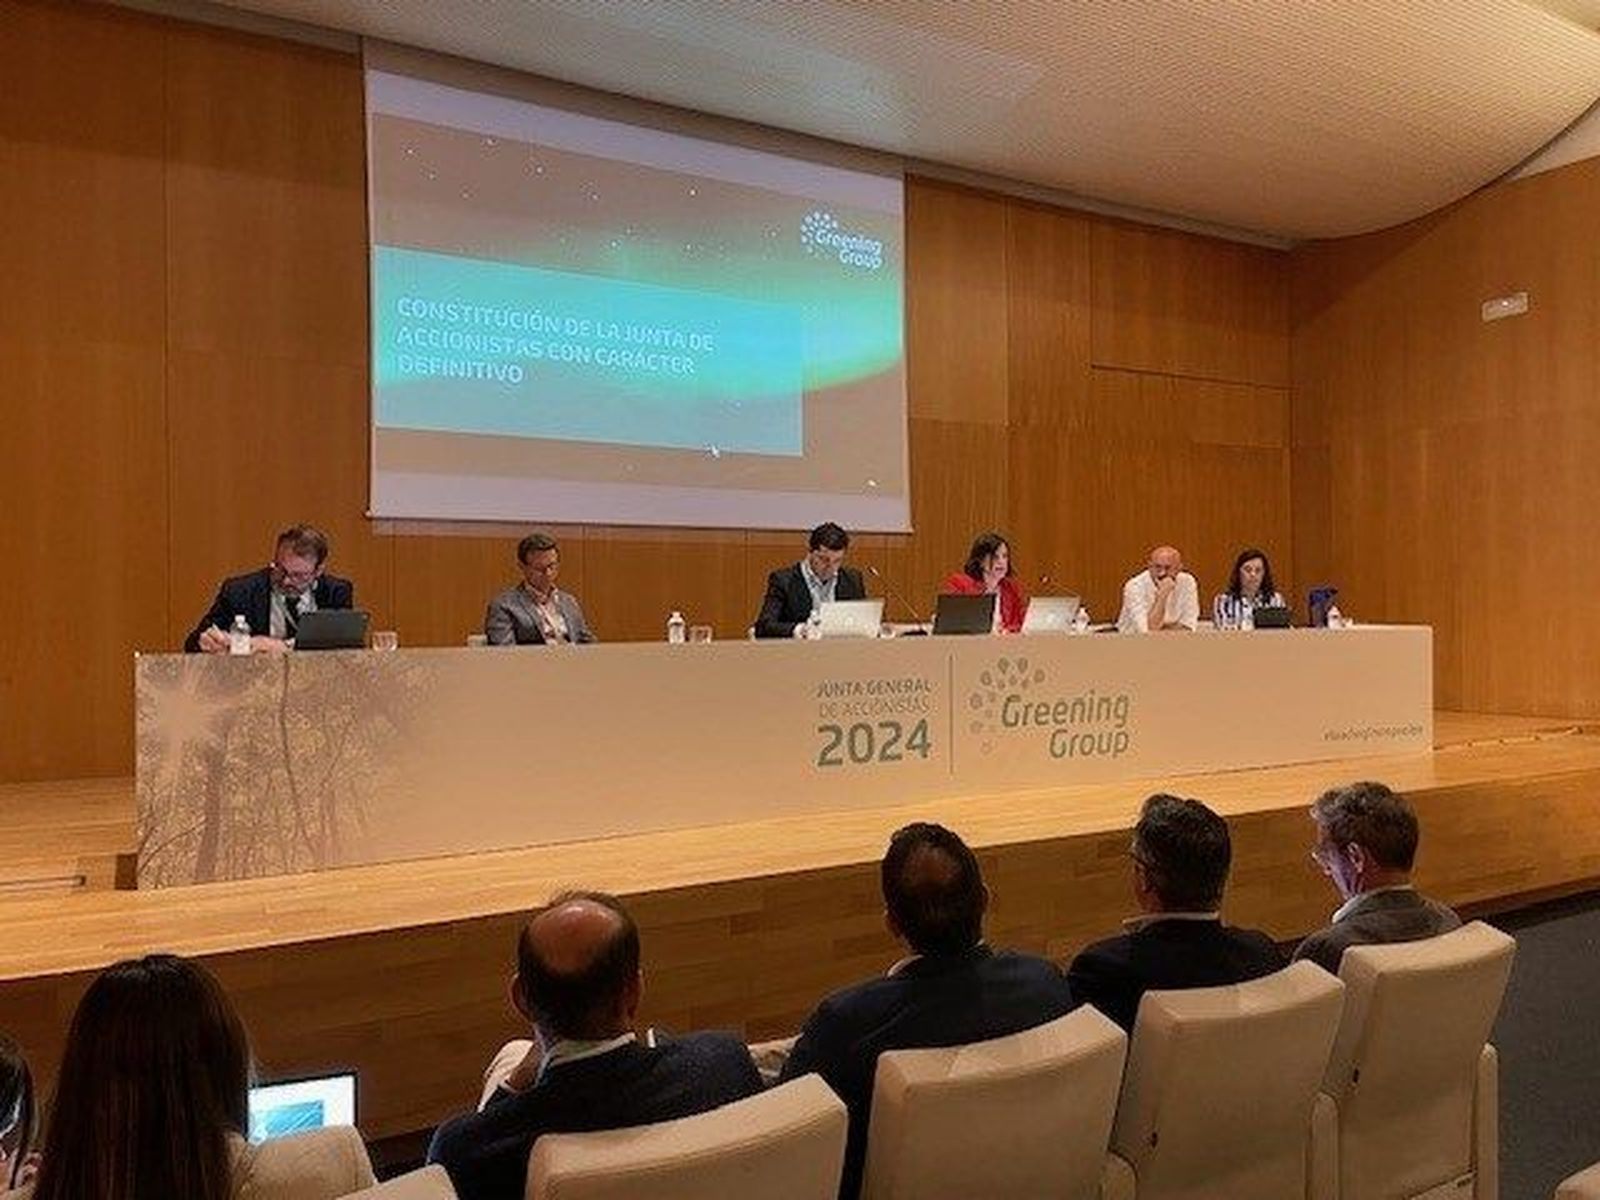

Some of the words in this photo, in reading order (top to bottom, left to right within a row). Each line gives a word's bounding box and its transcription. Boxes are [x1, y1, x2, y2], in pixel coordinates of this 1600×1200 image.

[816, 229, 882, 255] Greening
[840, 248, 882, 269] Group
[397, 297, 560, 333] CONSTITUCIÓN
[565, 316, 592, 337] DE
[596, 322, 621, 340] LA
[622, 325, 686, 349] JUNTA
[689, 333, 714, 351] DE
[396, 327, 544, 359] ACCIONISTAS
[549, 342, 591, 364] CON
[398, 354, 524, 384] DEFINITIVO
[816, 682, 863, 698] JUNTA
[866, 679, 933, 696] GENERAL
[819, 702, 838, 718] DE
[1001, 690, 1130, 729] Greening
[816, 718, 932, 767] 2024
[1049, 728, 1130, 760] Group
